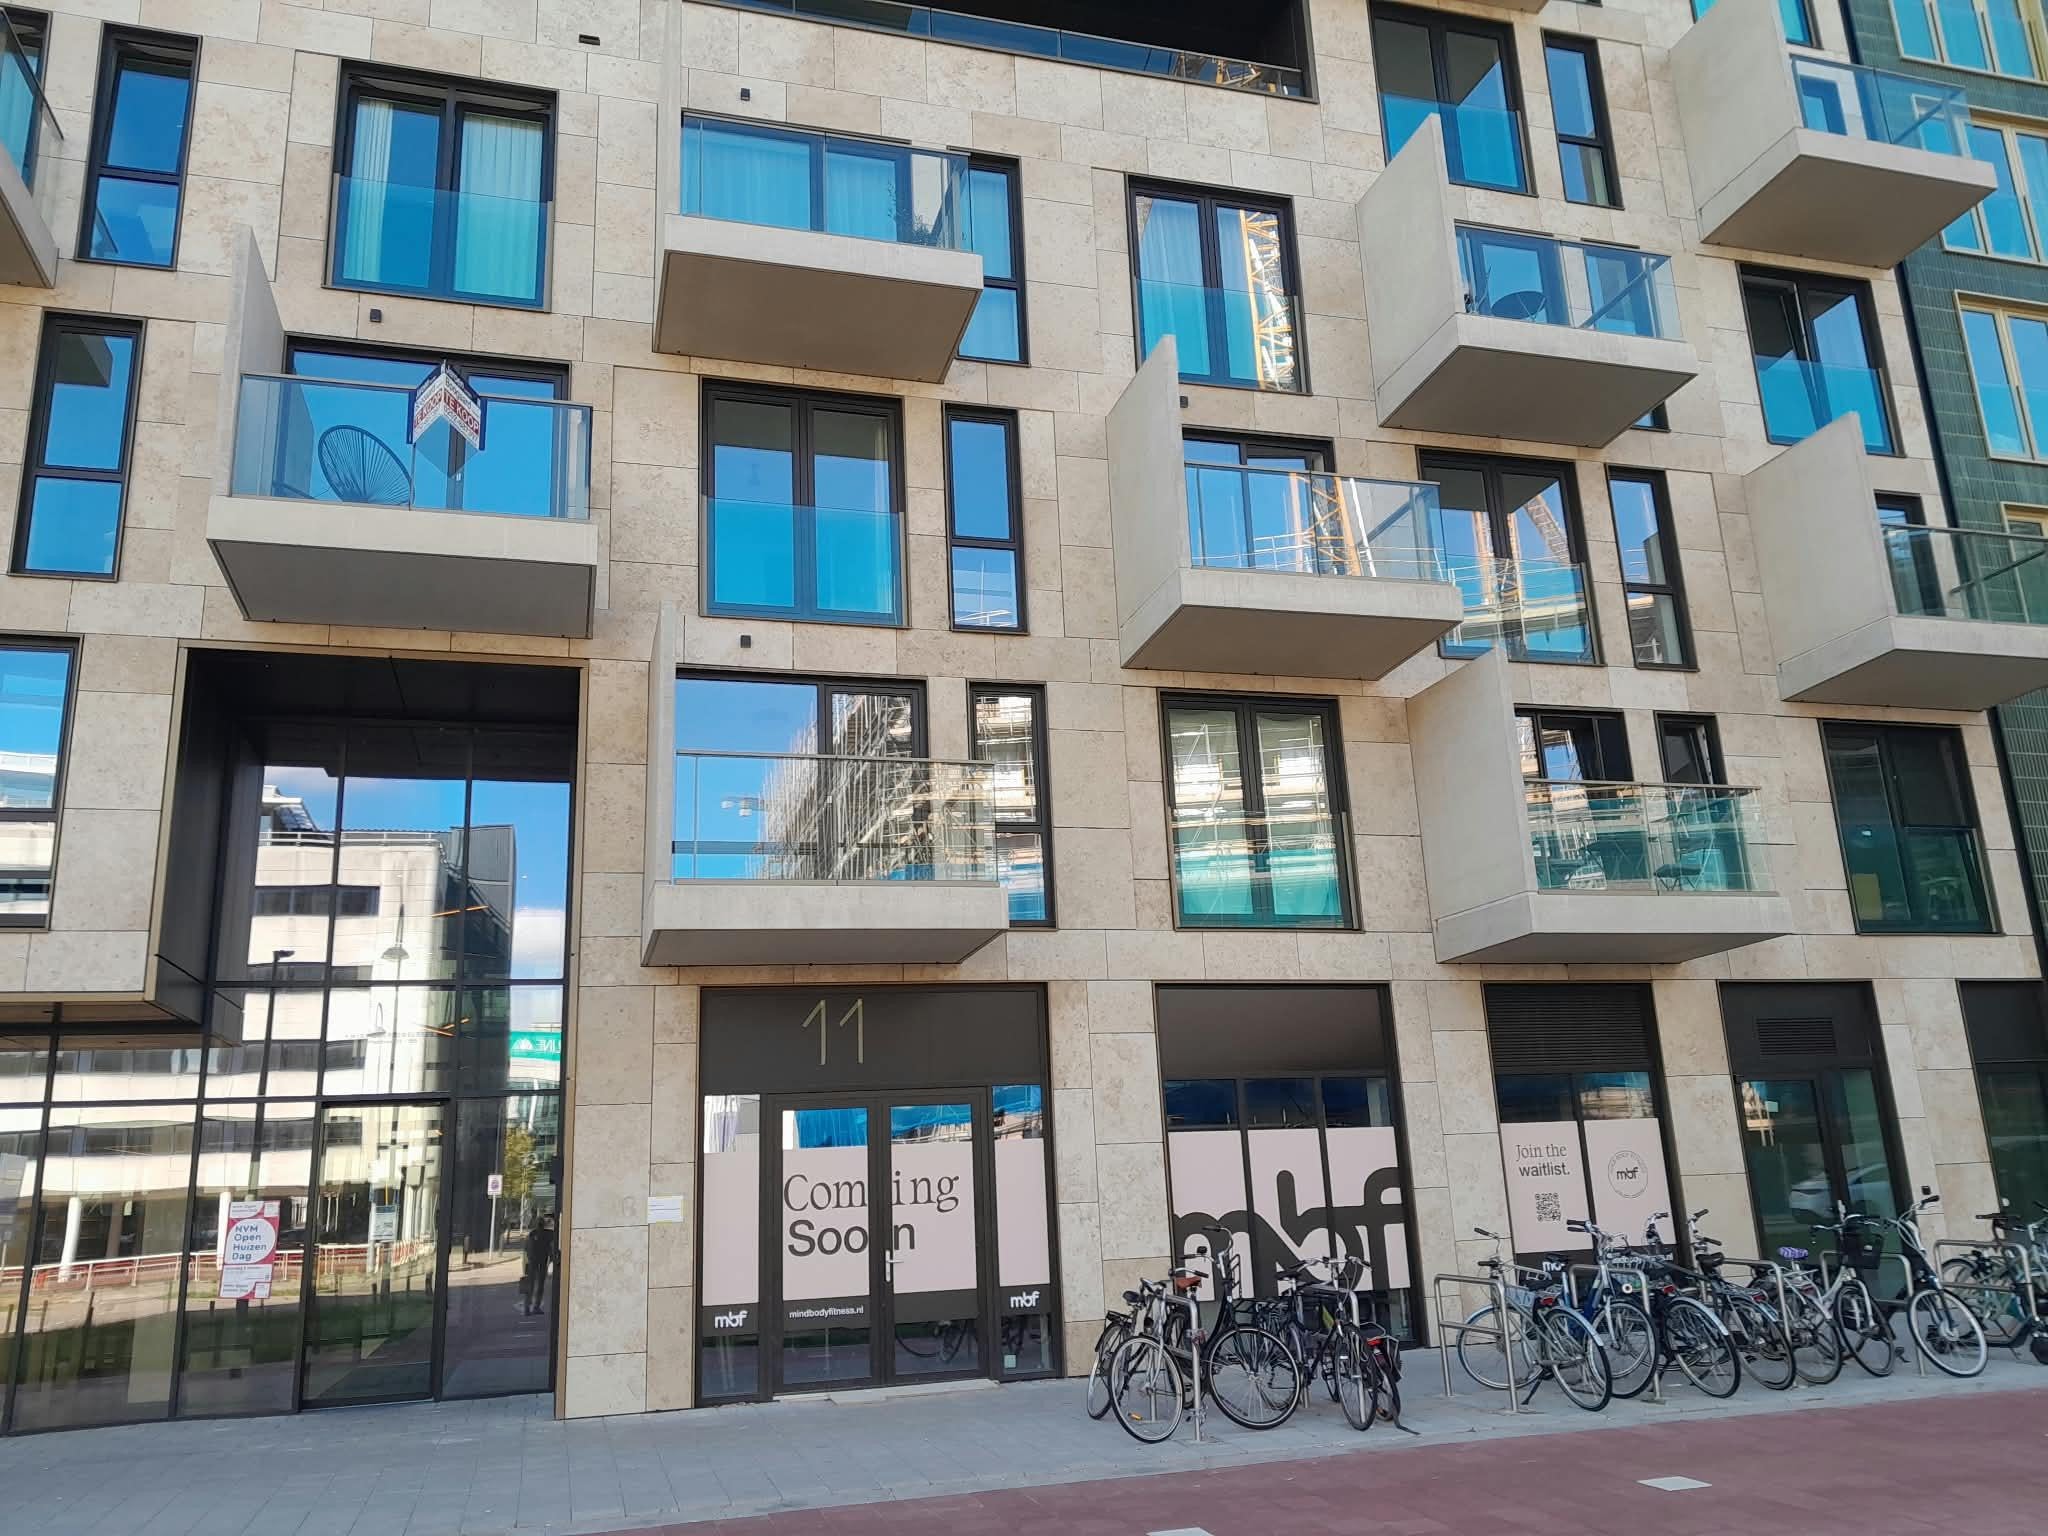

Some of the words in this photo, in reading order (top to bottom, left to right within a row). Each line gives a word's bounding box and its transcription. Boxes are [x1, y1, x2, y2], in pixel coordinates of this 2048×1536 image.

[456, 404, 479, 431] KOOP
[801, 998, 864, 1065] 11
[1515, 1144, 1543, 1162] Join
[1546, 1143, 1568, 1158] the
[1519, 1163, 1571, 1177] waitlist.
[1616, 1167, 1639, 1180] mbf
[783, 1170, 960, 1213] Coming
[235, 1225, 258, 1233] NVM
[234, 1234, 262, 1243] Open
[787, 1219, 916, 1257] Soon
[233, 1243, 267, 1251] Huizen
[232, 1252, 252, 1261] Dag
[1010, 1290, 1041, 1308] mbf
[714, 1310, 748, 1329] mbf
[788, 1305, 865, 1319] mindbodyfitness.nl
